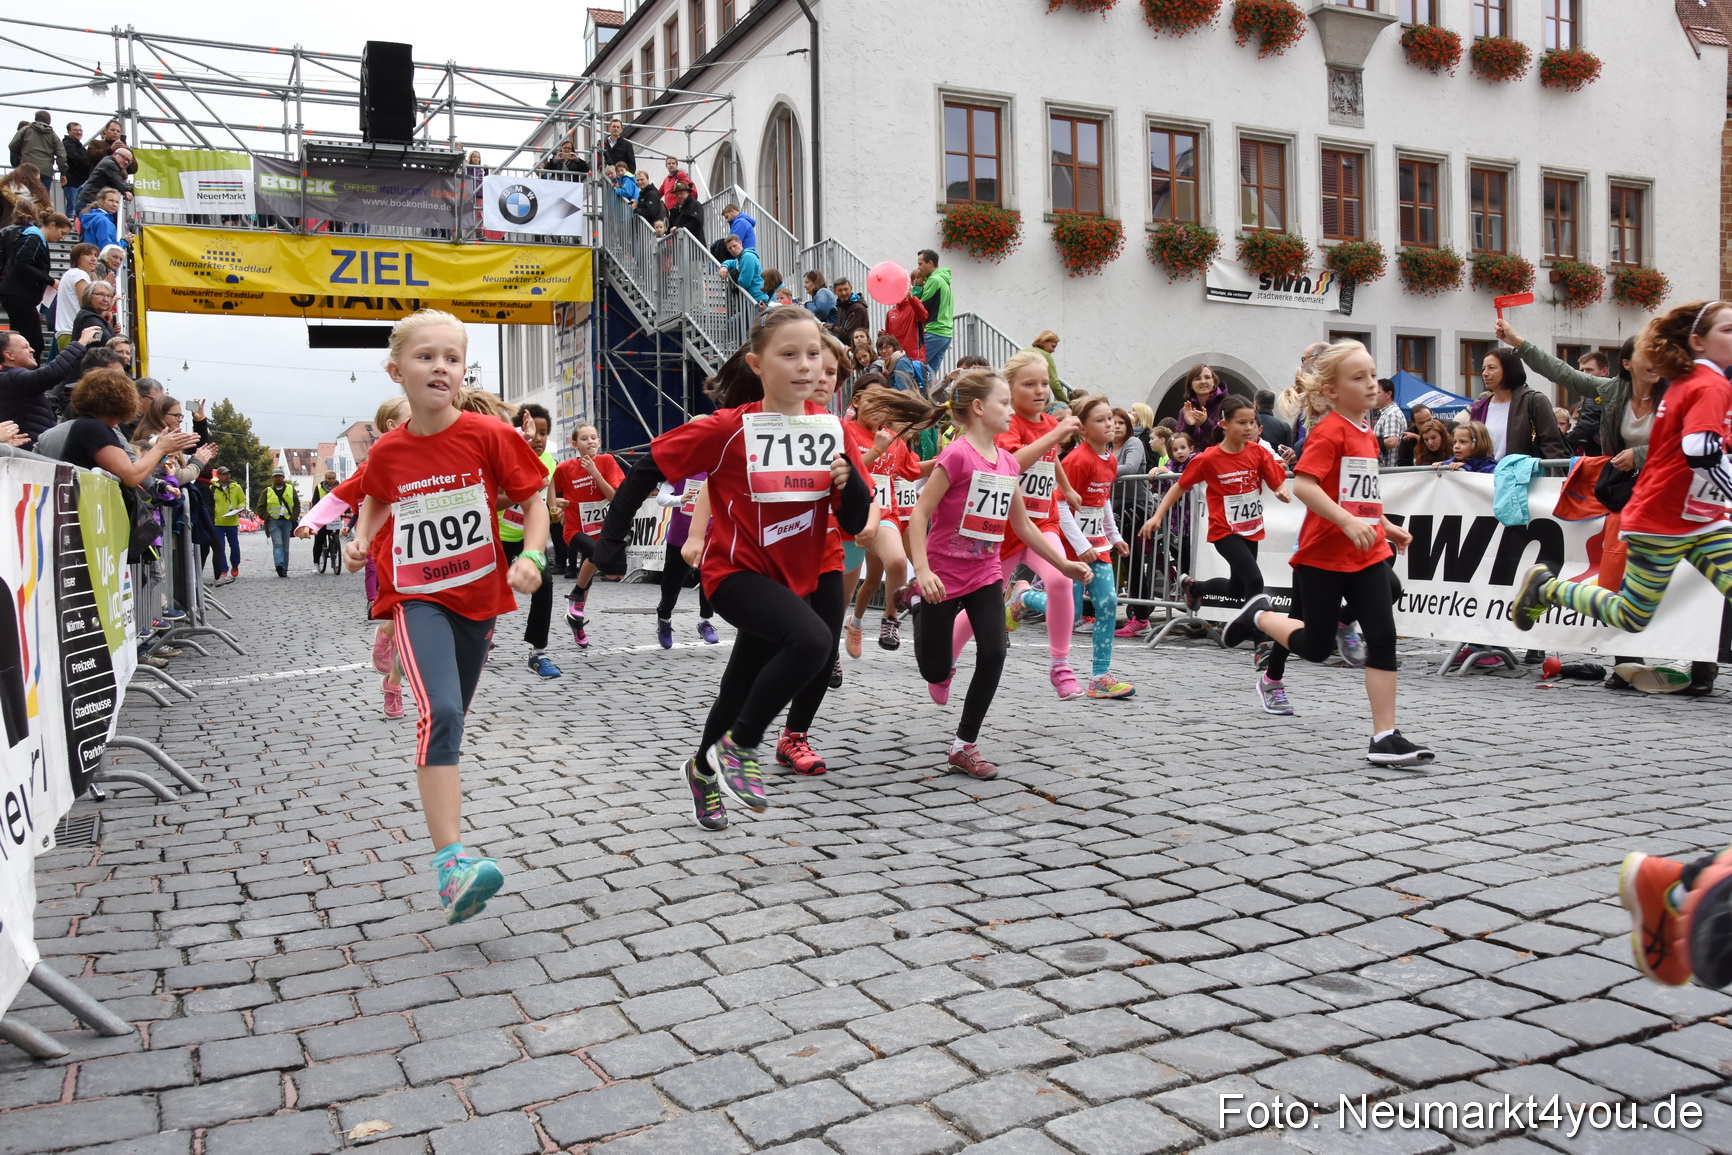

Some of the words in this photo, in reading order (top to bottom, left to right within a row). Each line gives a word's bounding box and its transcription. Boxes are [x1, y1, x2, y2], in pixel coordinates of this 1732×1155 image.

[134, 179, 161, 190] eht!
[260, 175, 336, 195] BOCK
[343, 183, 377, 193] OFFICE
[380, 186, 428, 196] INDUSTRY
[503, 185, 536, 200] BMW
[196, 192, 247, 200] NeuerMarkt
[362, 198, 452, 212] www.bockonline.de
[169, 258, 226, 270] Neumarkter
[229, 263, 273, 274] Stadtlauf
[329, 249, 429, 287] ZIEL
[482, 275, 532, 284] Neumarkter
[533, 275, 571, 284] Stadtlauf
[1259, 272, 1312, 295] swn
[1257, 292, 1293, 302] stadtwerke
[1294, 295, 1325, 305] neumarkt
[757, 433, 836, 467] 7132
[397, 473, 457, 494] Neumarkter
[784, 475, 815, 488] Anna
[1019, 472, 1054, 498] 7096
[1349, 473, 1381, 500] 703
[425, 489, 478, 510] BOCK
[897, 489, 916, 506] 156
[976, 488, 1011, 517] 715
[584, 502, 611, 523] 720
[1230, 499, 1263, 521] 7426
[400, 509, 485, 559] 7092
[777, 521, 802, 536] DEHN
[422, 559, 471, 580] Sophia
[1397, 588, 1478, 619] twerke
[66, 619, 86, 633] Wärme
[71, 656, 97, 675] Freizeit
[74, 698, 112, 719] Stadtbusse
